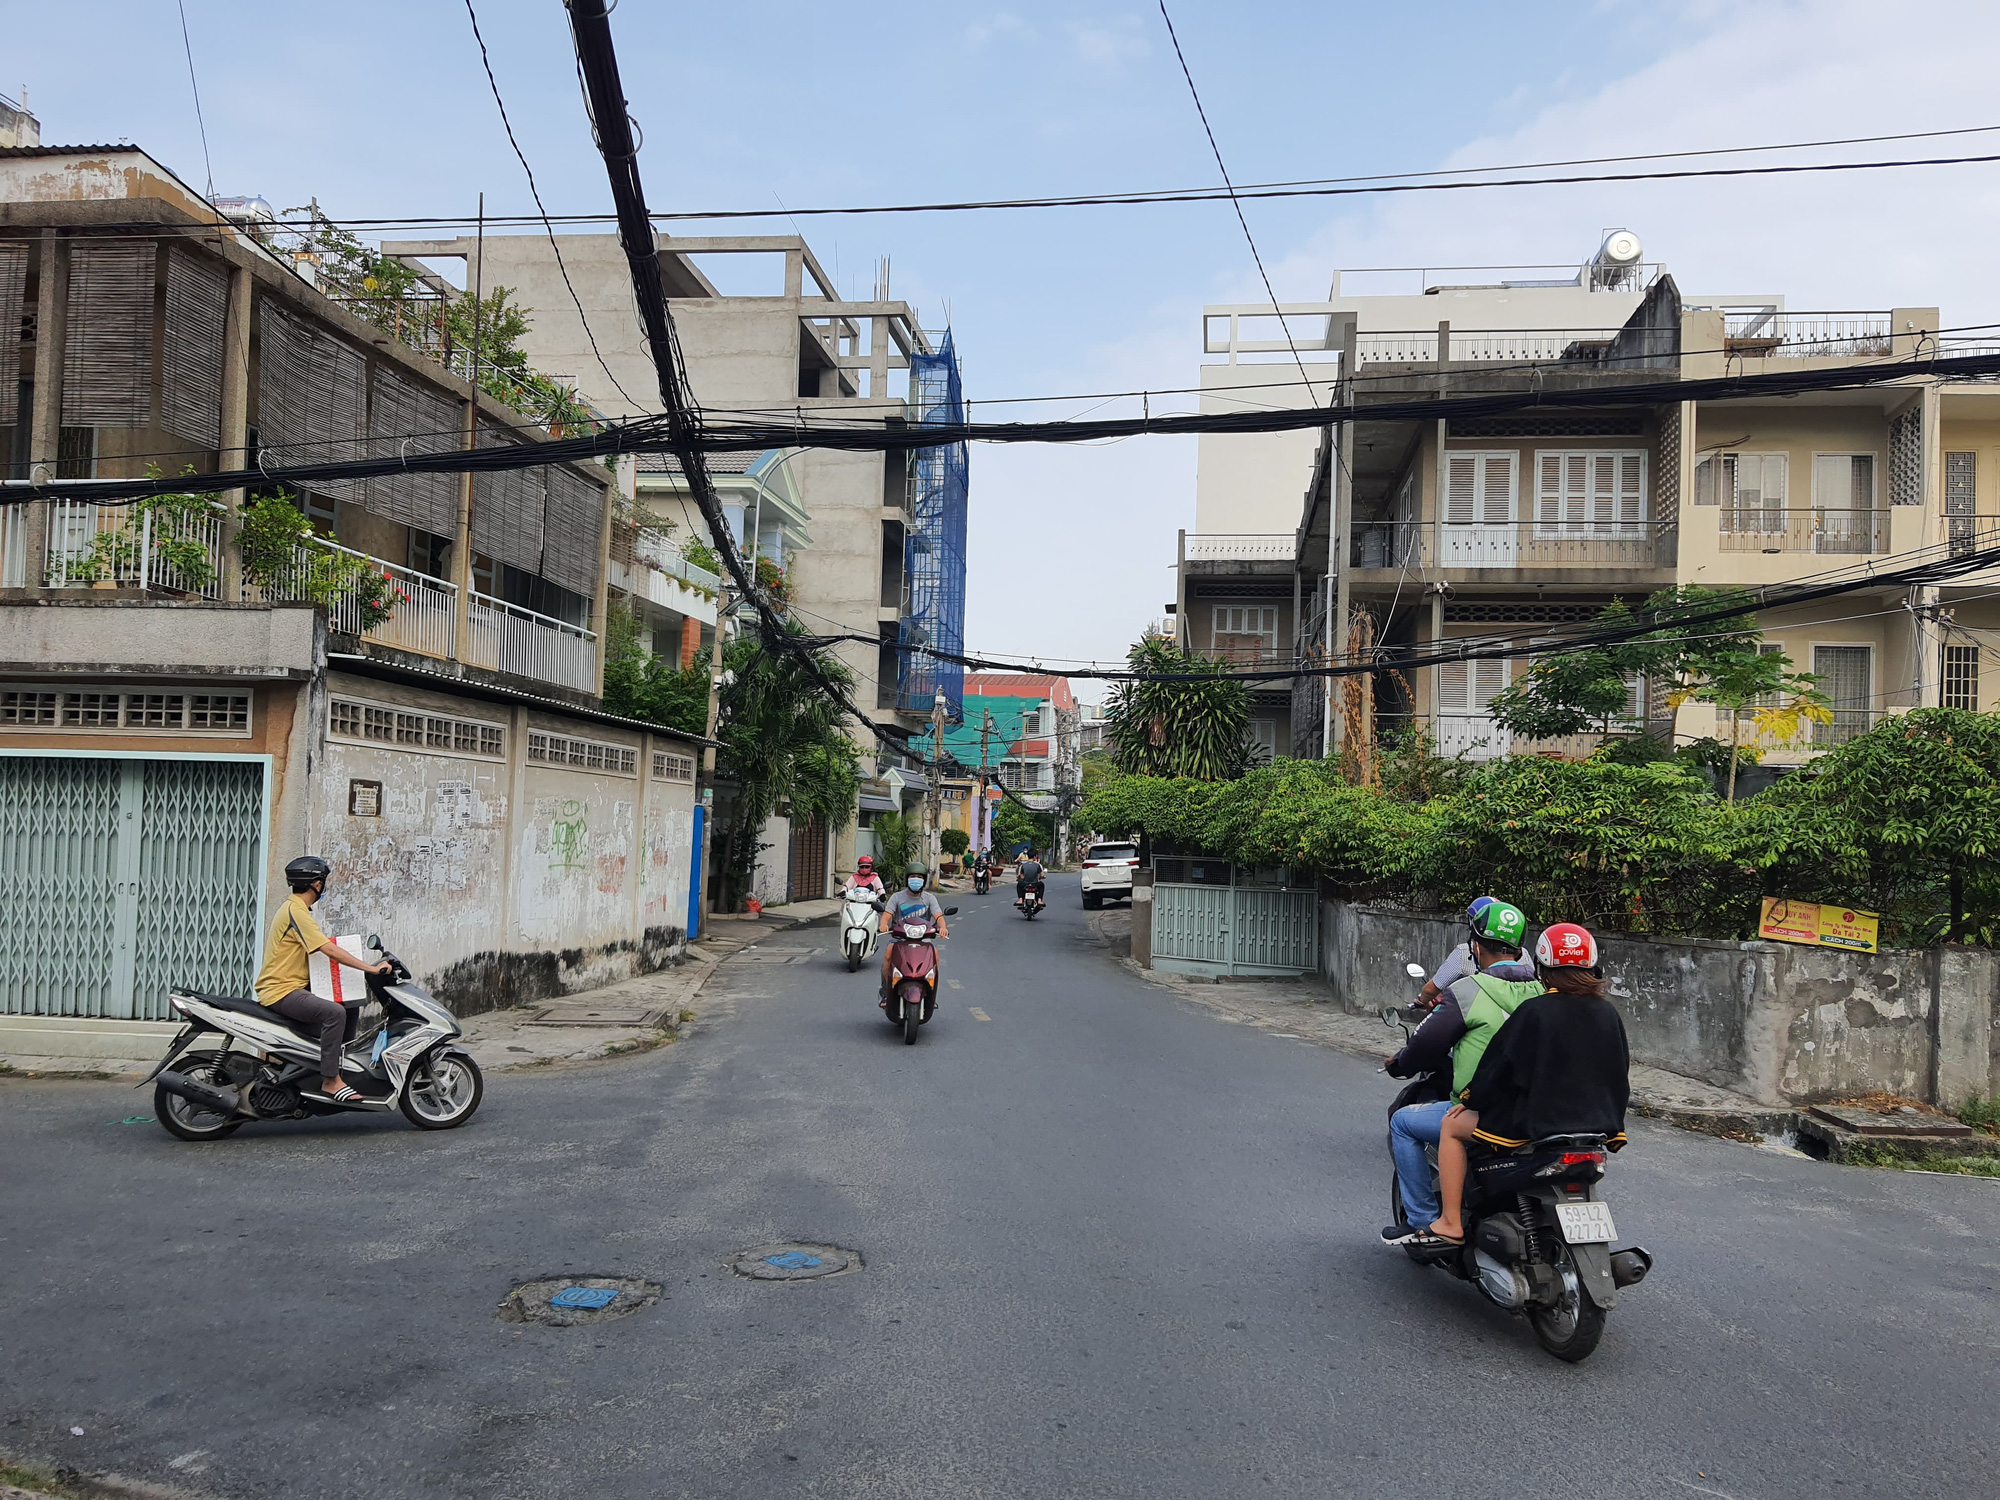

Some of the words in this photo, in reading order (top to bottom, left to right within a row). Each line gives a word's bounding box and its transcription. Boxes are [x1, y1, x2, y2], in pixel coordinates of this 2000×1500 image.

[1558, 949, 1584, 957] goviet
[1564, 1205, 1603, 1222] 59-L2
[1565, 1222, 1612, 1240] 227.21
